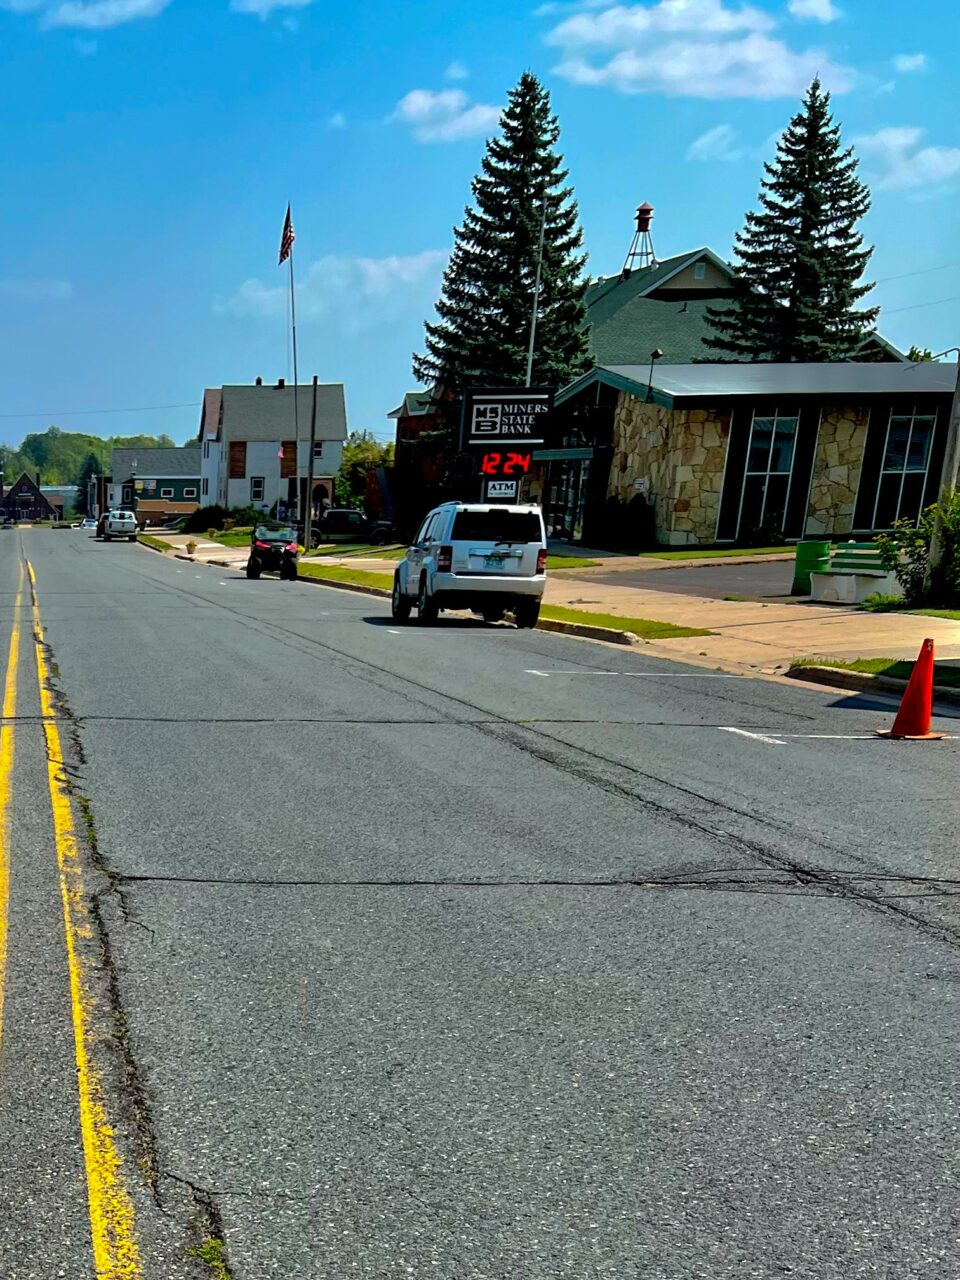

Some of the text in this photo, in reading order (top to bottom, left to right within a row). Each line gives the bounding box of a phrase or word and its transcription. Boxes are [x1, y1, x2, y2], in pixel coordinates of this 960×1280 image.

[503, 404, 548, 413] MINERS
[502, 415, 536, 424] STATE
[501, 425, 531, 434] BANK
[490, 482, 515, 491] ATM
